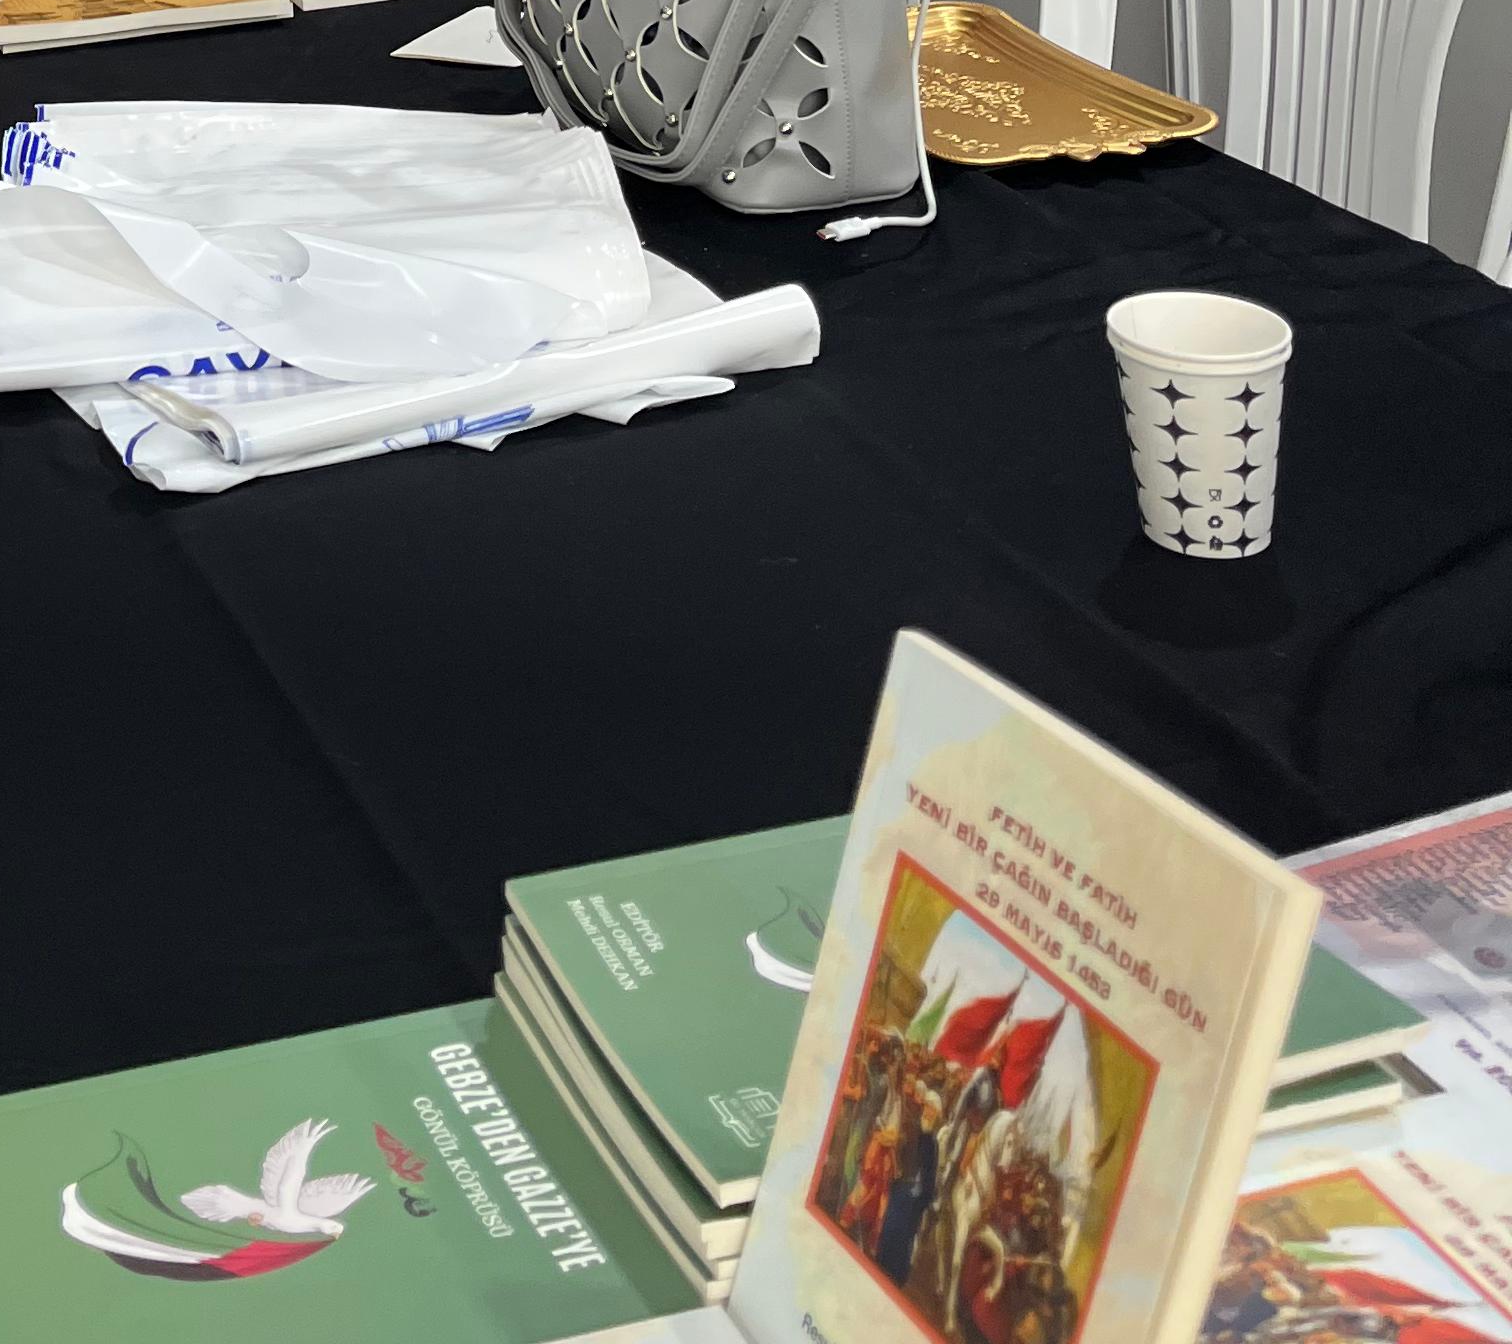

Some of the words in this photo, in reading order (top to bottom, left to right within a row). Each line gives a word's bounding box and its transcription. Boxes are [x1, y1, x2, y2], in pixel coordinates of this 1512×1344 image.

[620, 901, 664, 953] EDİTÖR
[907, 783, 952, 829] YENİ
[954, 821, 988, 857] BİR
[992, 851, 1051, 907] ÇAĞIN
[1056, 899, 1160, 995] BAŞLADIĞI
[1162, 987, 1208, 1034] GÜN
[989, 806, 1046, 858] FETİH
[1050, 851, 1076, 881] VE
[1079, 874, 1139, 930] FATİH
[592, 936, 638, 991] DEHKAN
[612, 929, 656, 977] ORMAN
[975, 882, 1000, 908] 29
[1003, 903, 1064, 961] MAYIS
[1067, 954, 1112, 1001] 1453
[413, 1096, 461, 1158] GÖNÜL
[446, 1156, 515, 1238] KÖPRÜSÜ
[430, 1043, 536, 1166] GEBZE'DEN
[503, 1165, 607, 1273] GAZZE'YE
